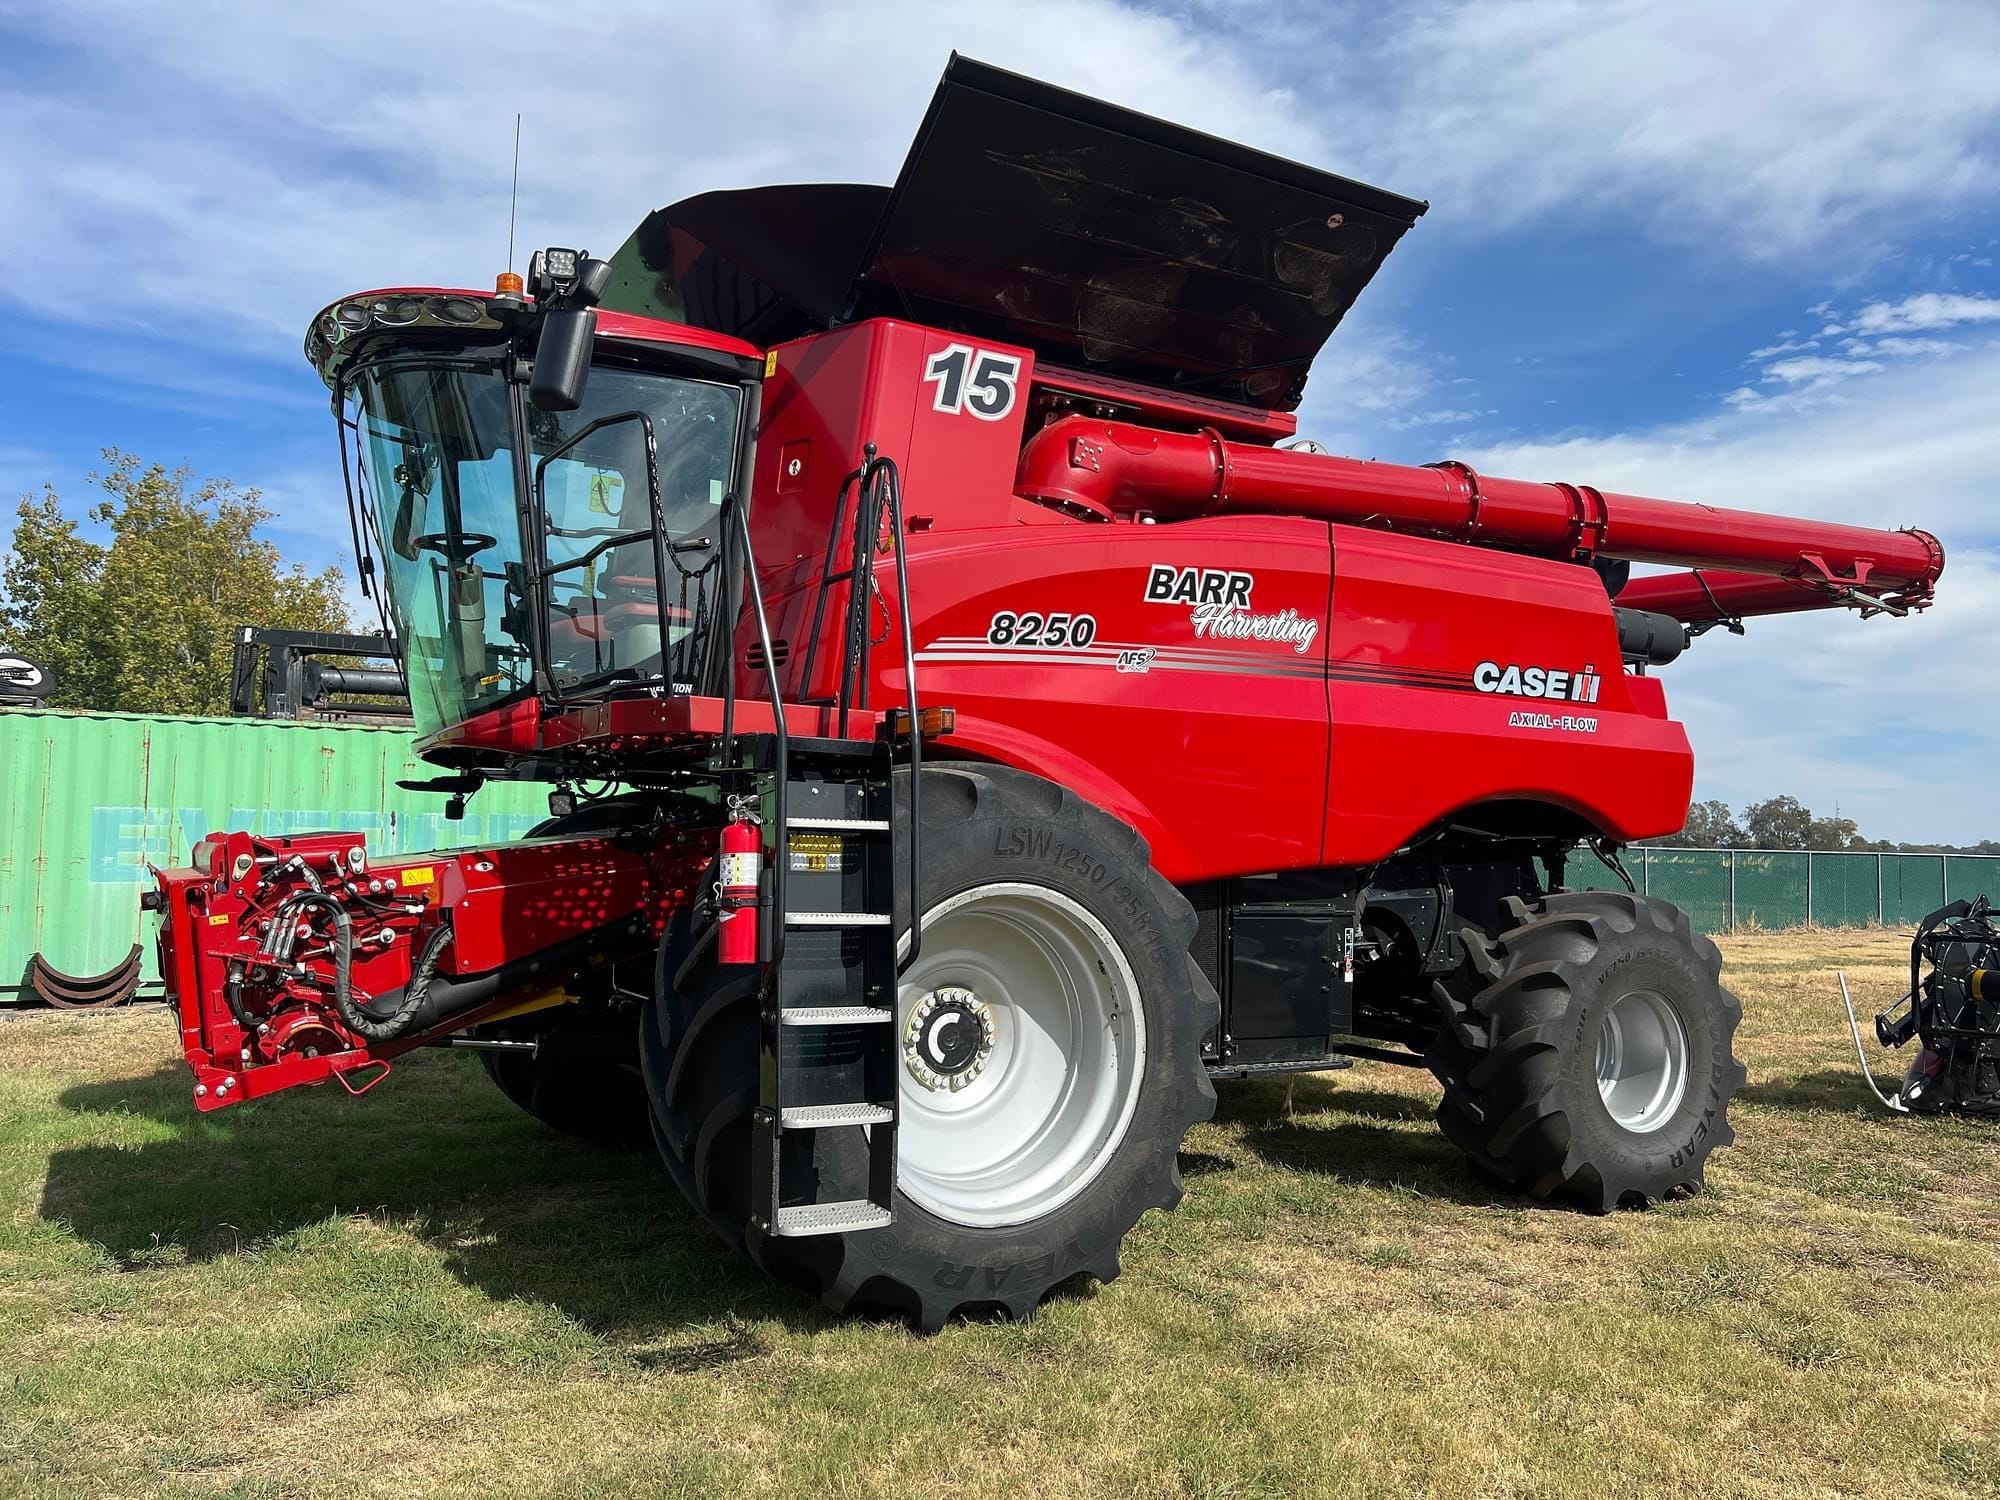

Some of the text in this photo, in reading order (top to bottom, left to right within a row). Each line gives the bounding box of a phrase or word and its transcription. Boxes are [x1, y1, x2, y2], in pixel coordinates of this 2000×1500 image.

[924, 343, 1021, 420] 15
[1145, 565, 1253, 609] BARR
[987, 611, 1096, 649] 8250
[1190, 602, 1319, 654] Harvesting
[1117, 650, 1148, 666] AFS
[1473, 662, 1569, 699] CASE
[1508, 711, 1598, 732] AXIAL-FLOW
